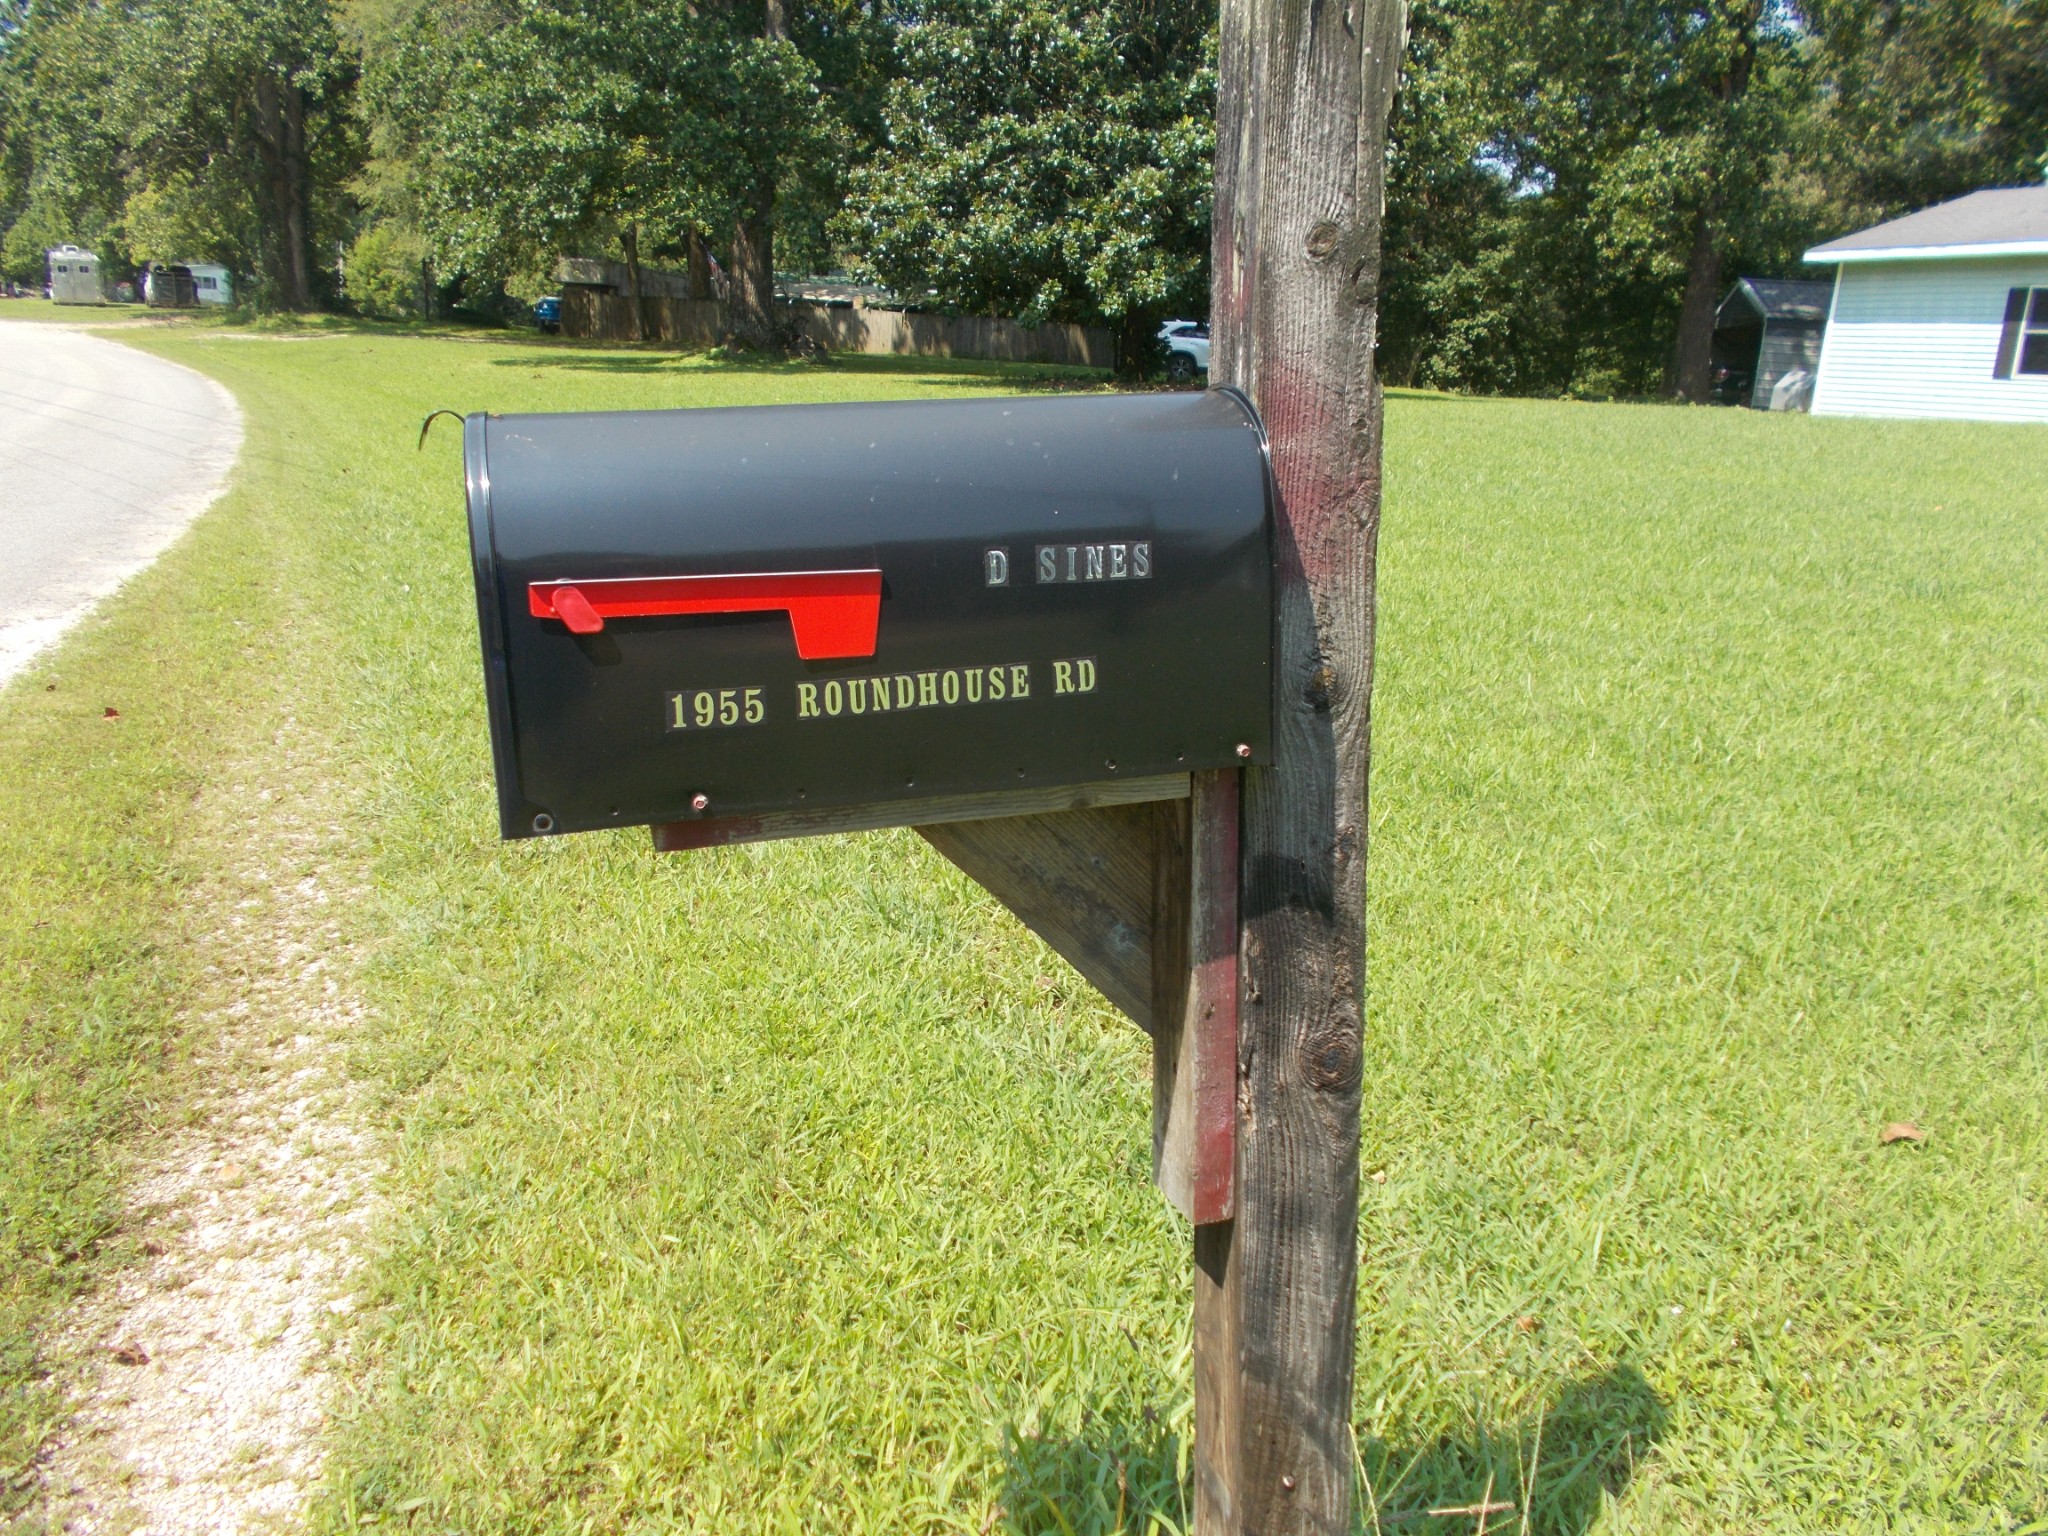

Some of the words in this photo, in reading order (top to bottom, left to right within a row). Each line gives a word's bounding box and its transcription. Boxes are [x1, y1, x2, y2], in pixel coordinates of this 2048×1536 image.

[988, 549, 1008, 585] D
[1039, 543, 1150, 582] SINES
[672, 688, 765, 729] 1955
[798, 665, 1030, 717] ROUNDHOUSE
[1053, 659, 1096, 694] RD
